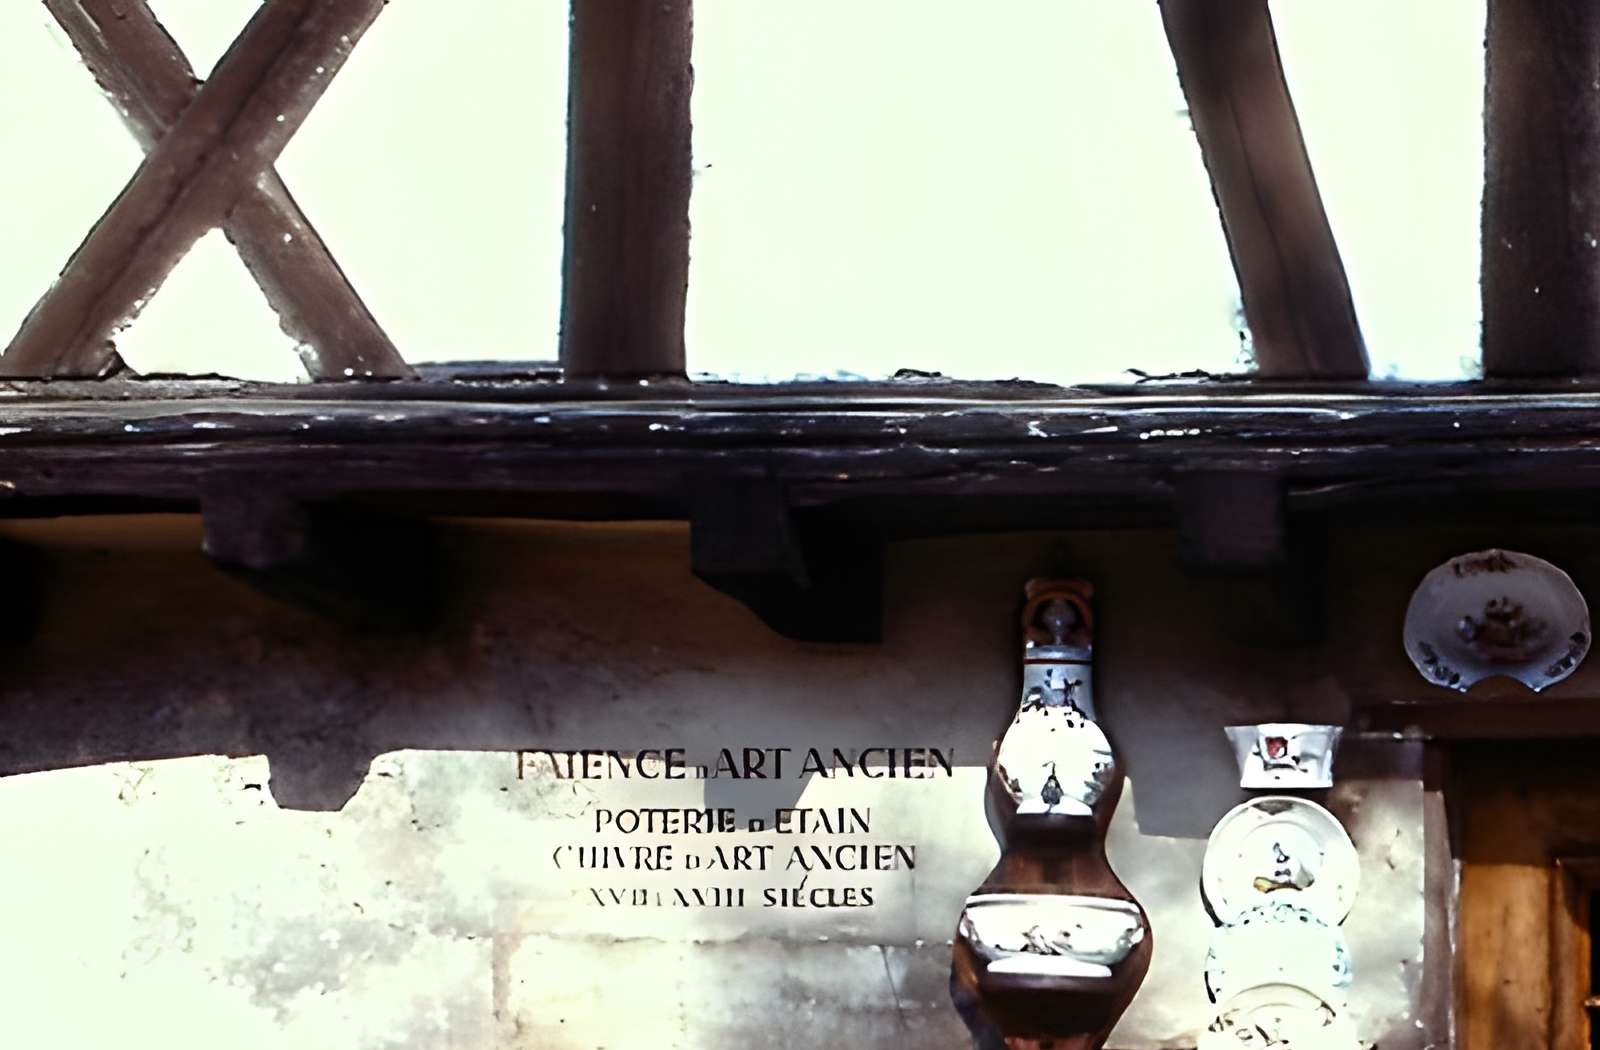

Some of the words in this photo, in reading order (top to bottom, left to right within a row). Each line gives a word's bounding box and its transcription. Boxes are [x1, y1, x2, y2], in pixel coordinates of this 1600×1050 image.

[799, 747, 954, 780] ANCIEN
[595, 807, 736, 835] POTERIE
[785, 845, 917, 872] ANCIEN
